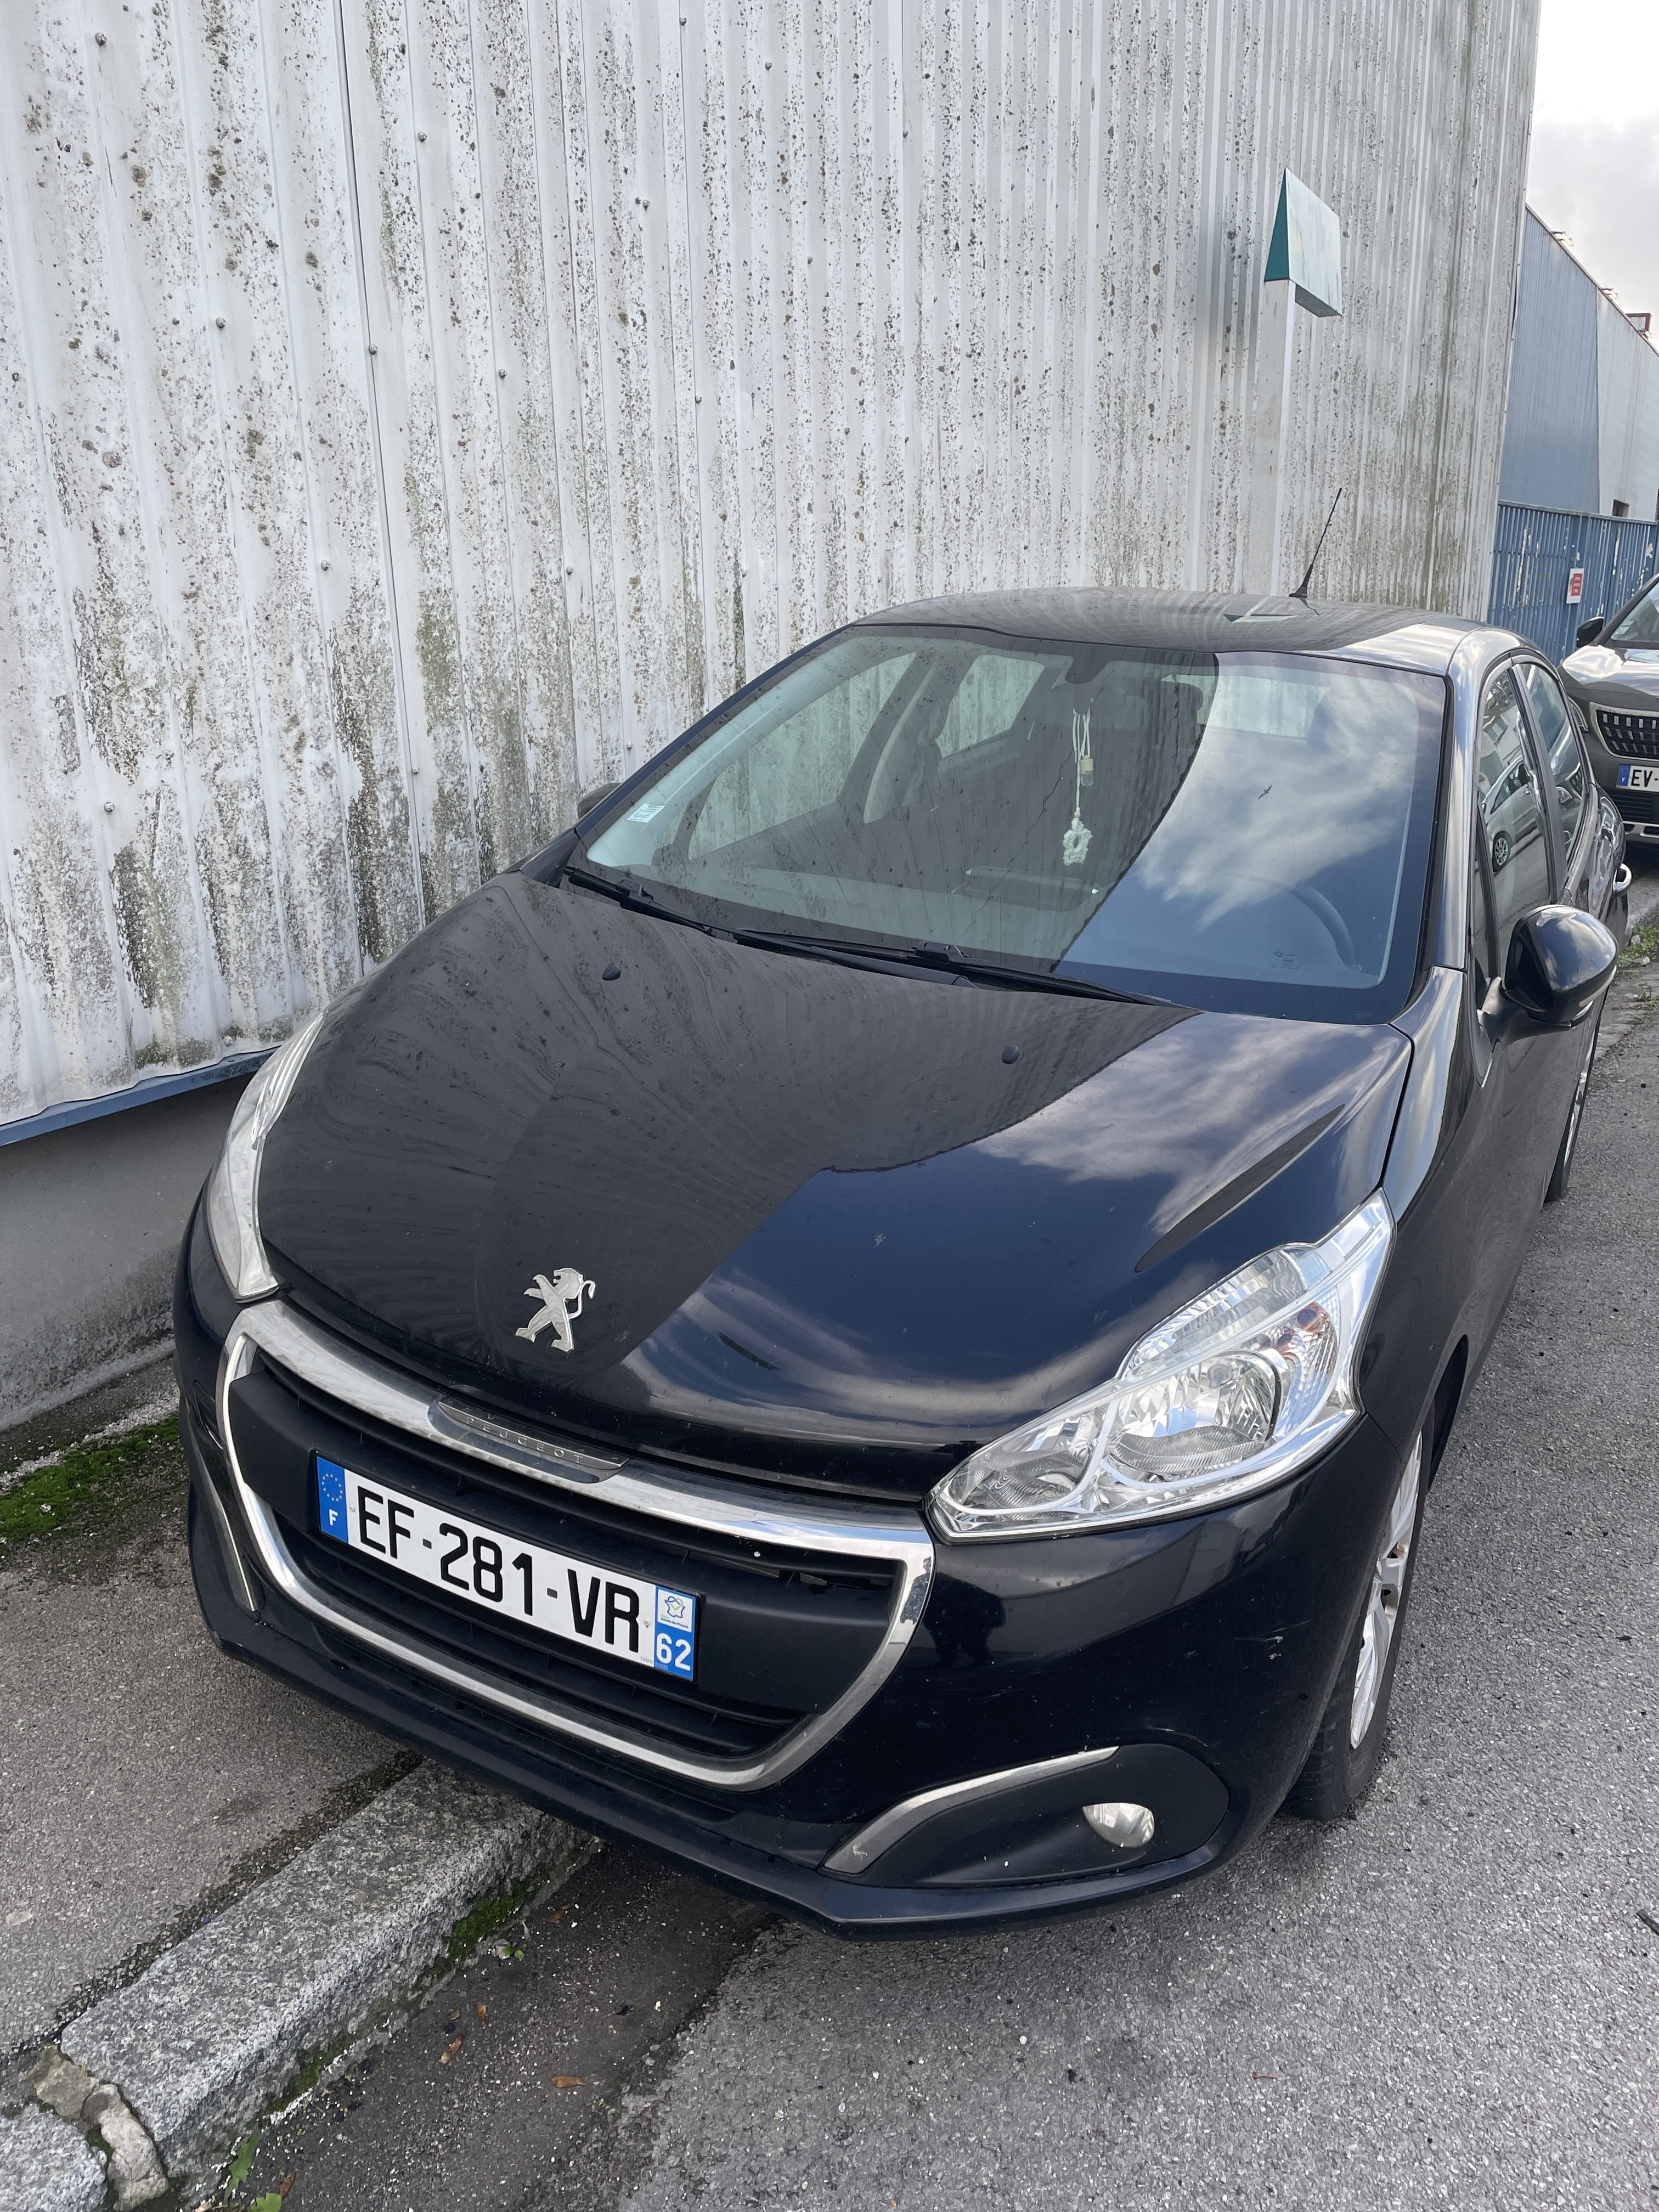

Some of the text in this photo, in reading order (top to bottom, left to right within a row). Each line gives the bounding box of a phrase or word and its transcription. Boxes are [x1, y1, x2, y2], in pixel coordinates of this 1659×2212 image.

[466, 1417, 584, 1464] PEUGEOT
[329, 1509, 338, 1526] F
[357, 1485, 639, 1654] EF-281-VR
[656, 1633, 691, 1671] 62
